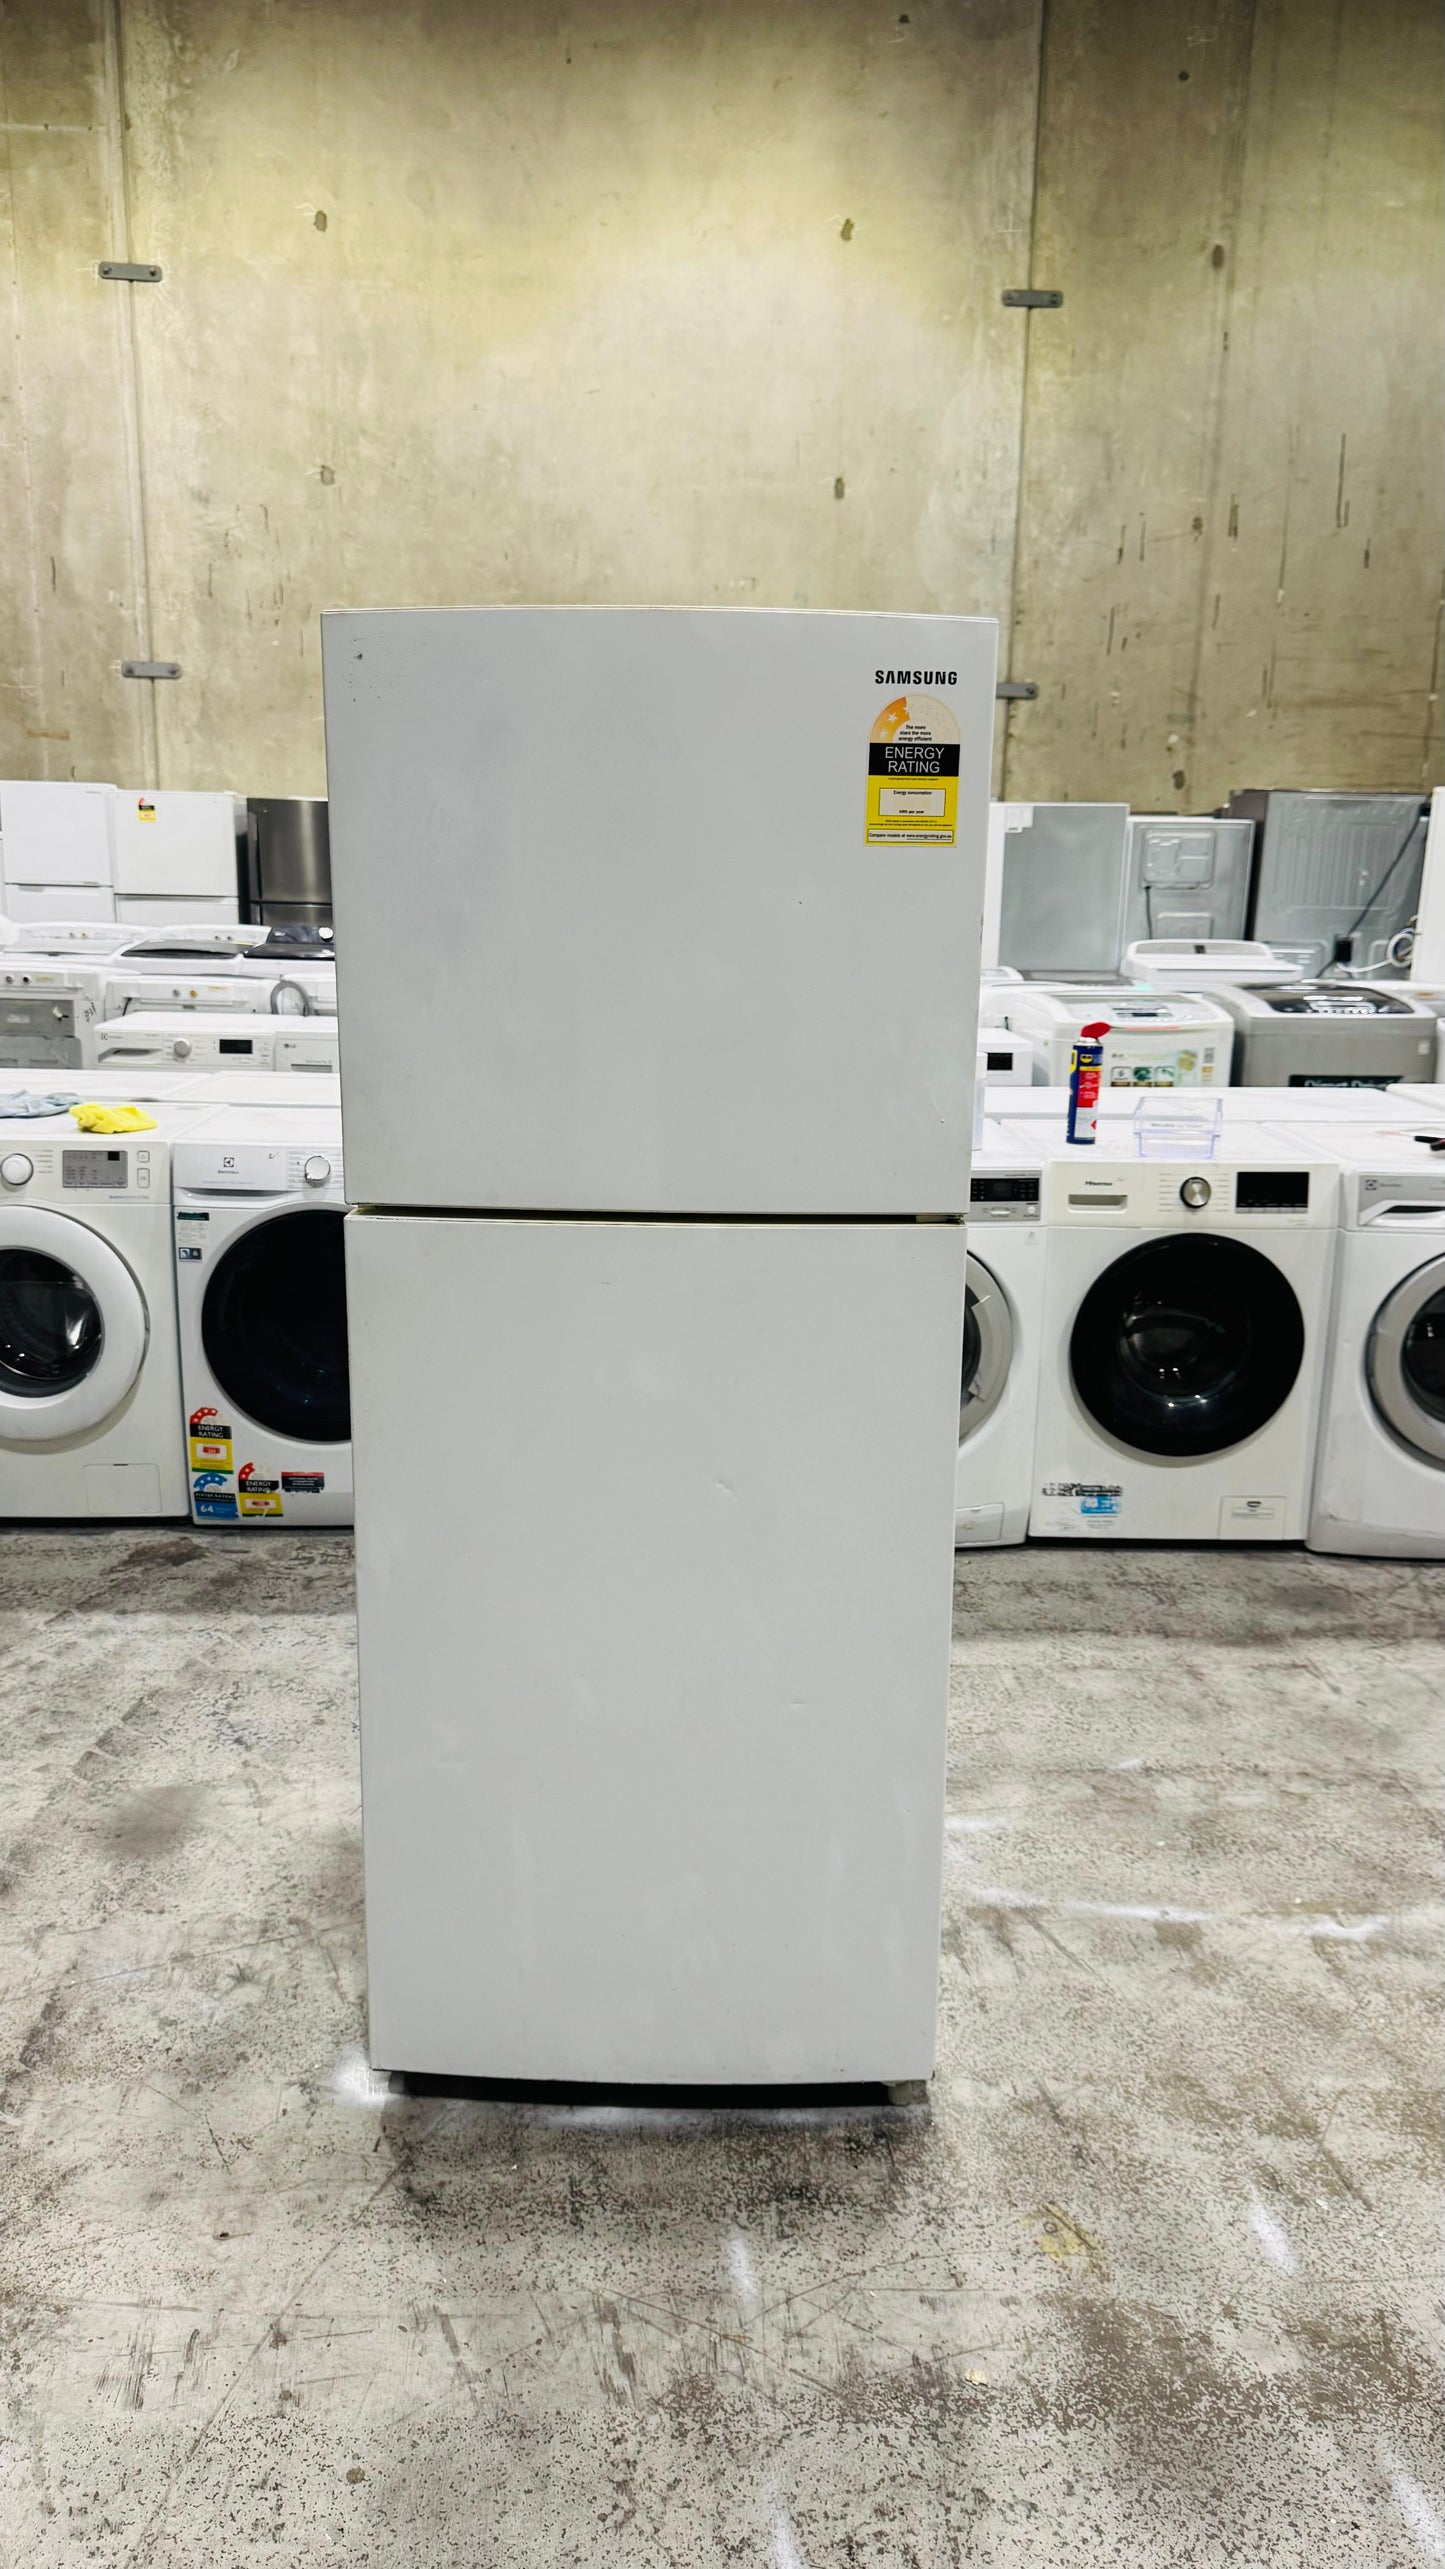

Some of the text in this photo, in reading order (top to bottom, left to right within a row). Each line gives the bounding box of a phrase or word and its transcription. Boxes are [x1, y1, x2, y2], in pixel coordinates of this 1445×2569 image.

[875, 670, 957, 685] SAMSUNG
[885, 746, 945, 759] ENERGY
[888, 760, 940, 773] RATING
[200, 1505, 214, 1513] 64
